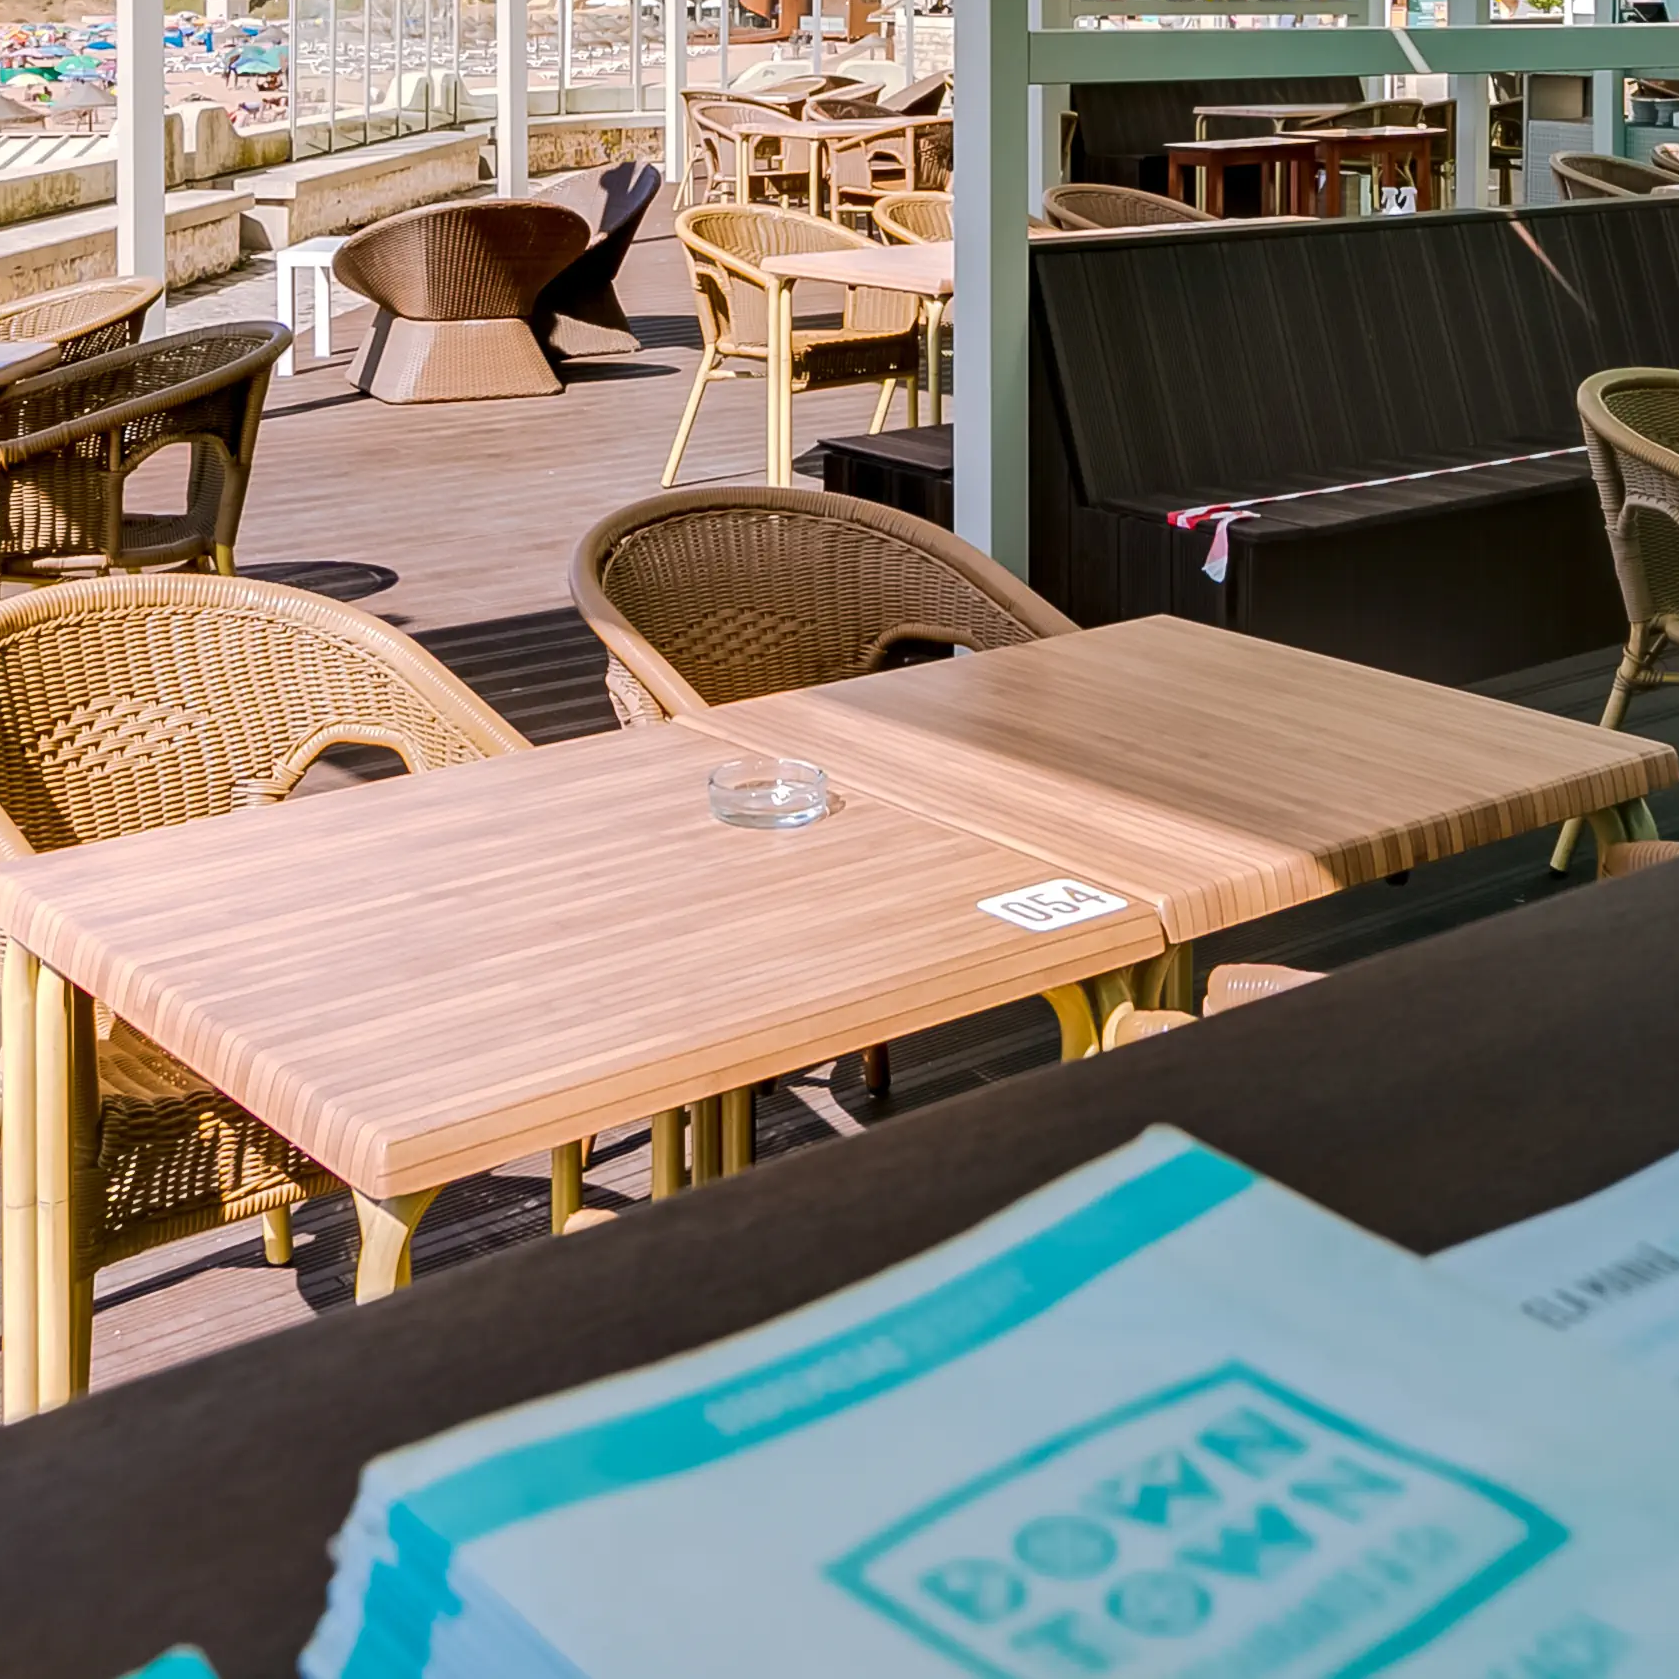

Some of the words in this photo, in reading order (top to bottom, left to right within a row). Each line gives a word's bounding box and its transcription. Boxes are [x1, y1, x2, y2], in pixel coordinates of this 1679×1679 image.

[1001, 885, 1107, 922] 054
[919, 1405, 1310, 1626] DOWN
[1007, 1455, 1407, 1675] TOWN
